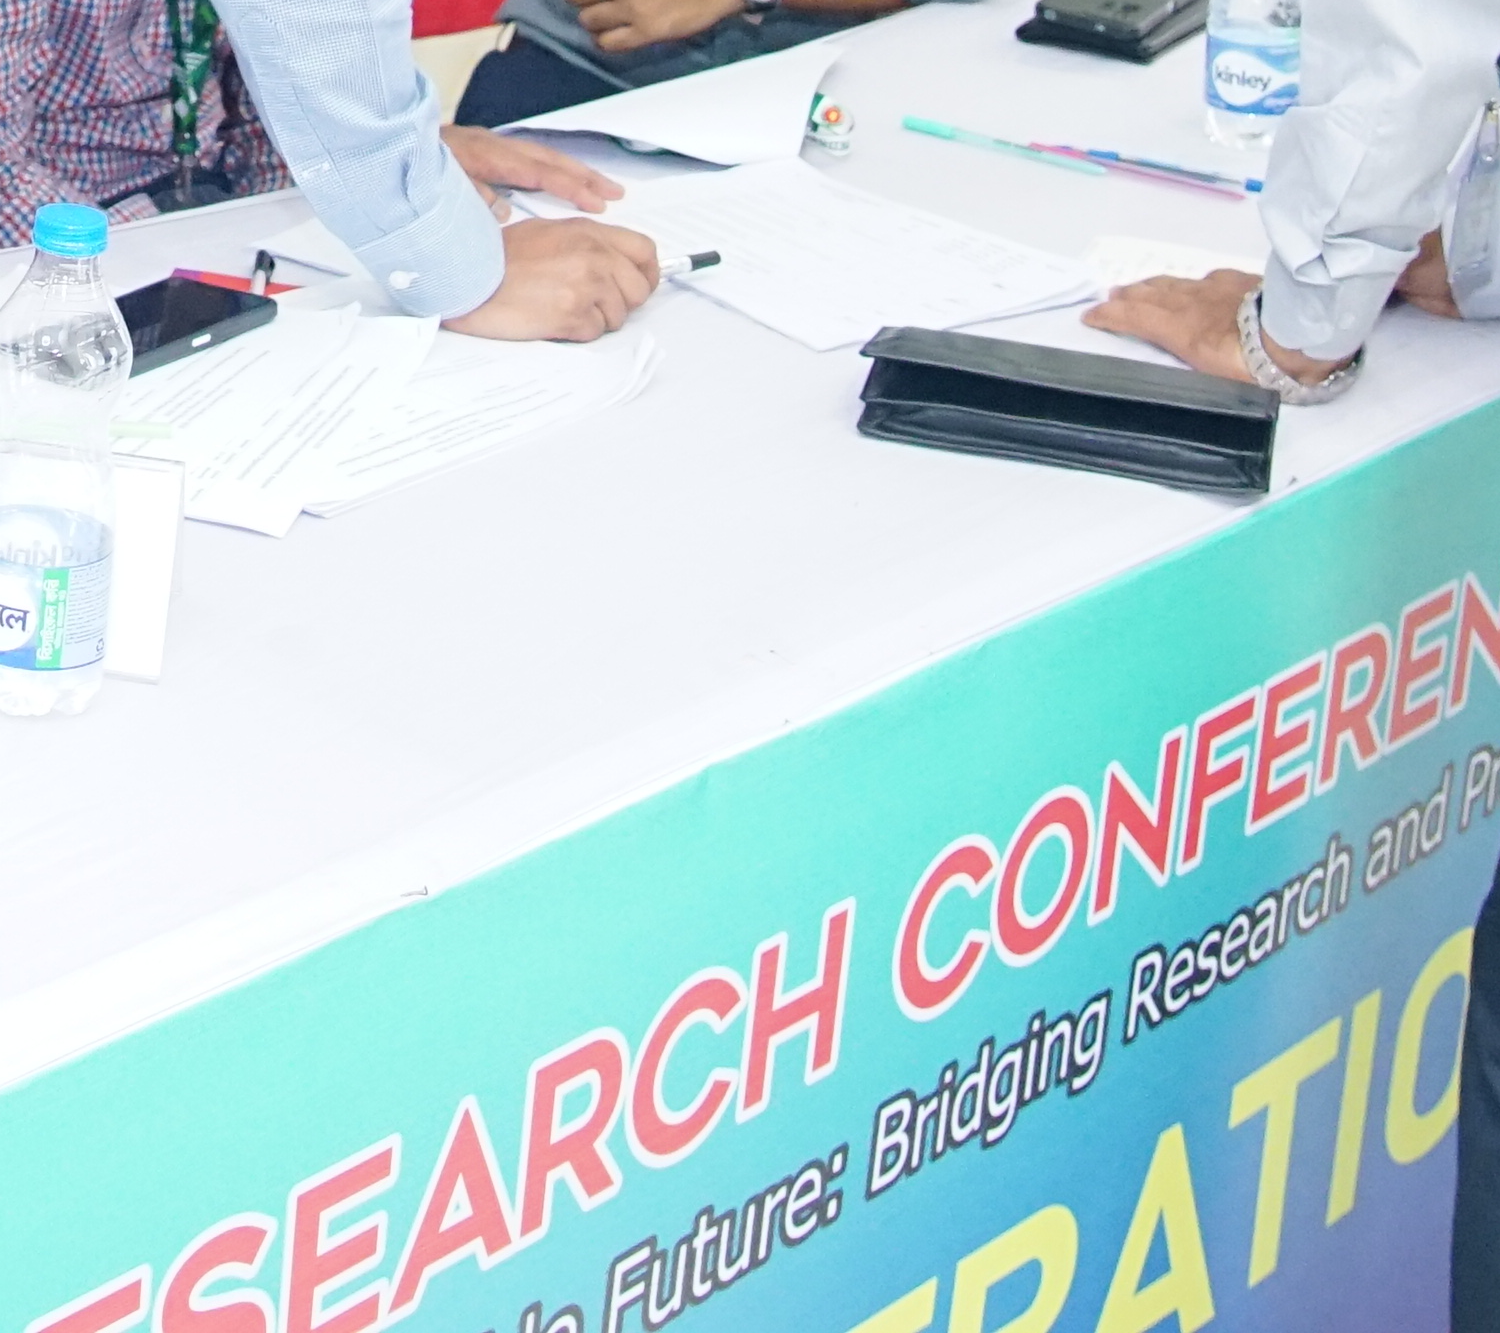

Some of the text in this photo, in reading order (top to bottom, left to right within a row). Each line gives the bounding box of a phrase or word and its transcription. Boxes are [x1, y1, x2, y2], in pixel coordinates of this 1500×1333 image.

[24, 895, 857, 1333] SEARCH
[600, 1141, 852, 1333] Future:
[866, 987, 1113, 1204] Bridging
[1121, 833, 1355, 1045] Research
[1360, 759, 1456, 897] and
